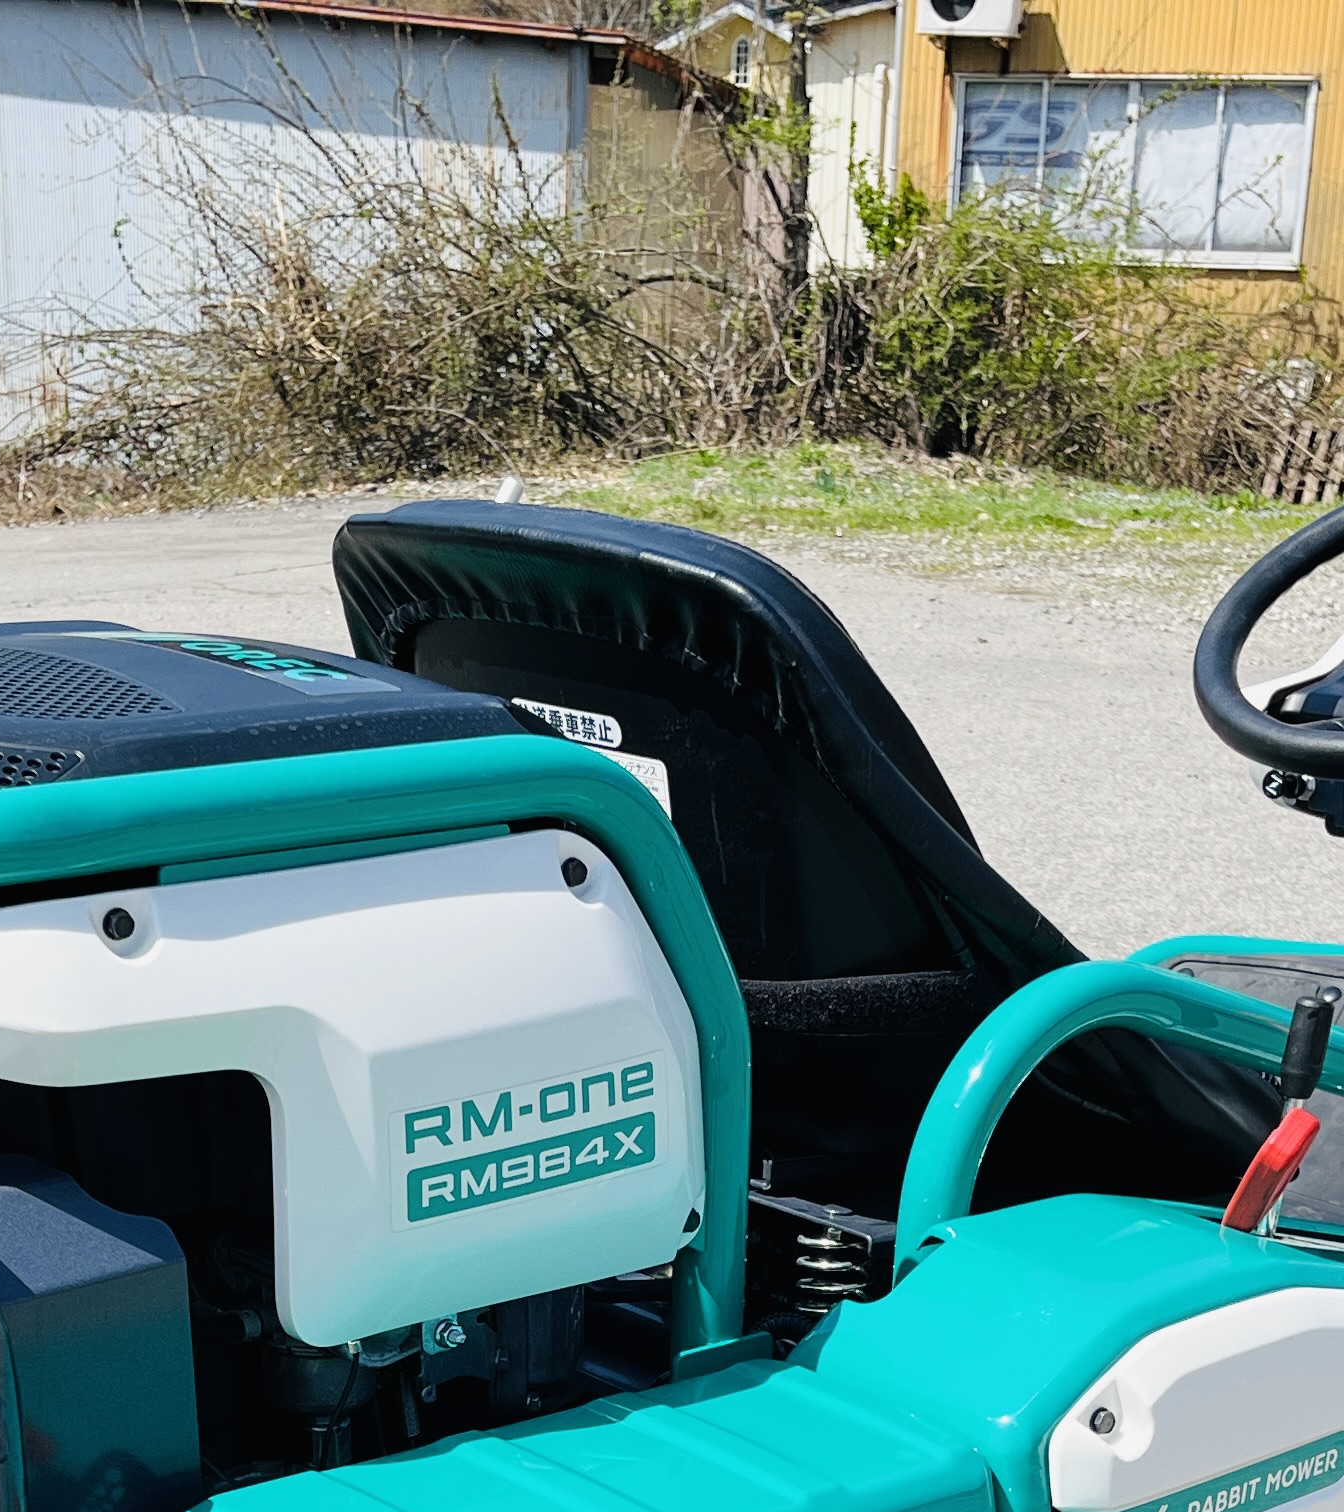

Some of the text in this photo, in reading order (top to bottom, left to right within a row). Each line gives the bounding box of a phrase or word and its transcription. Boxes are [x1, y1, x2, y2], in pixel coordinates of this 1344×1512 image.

[180, 641, 348, 683] OREC
[404, 1061, 654, 1154] RM-one
[421, 1125, 644, 1208] RM984X
[1264, 1447, 1339, 1496] MOWER
